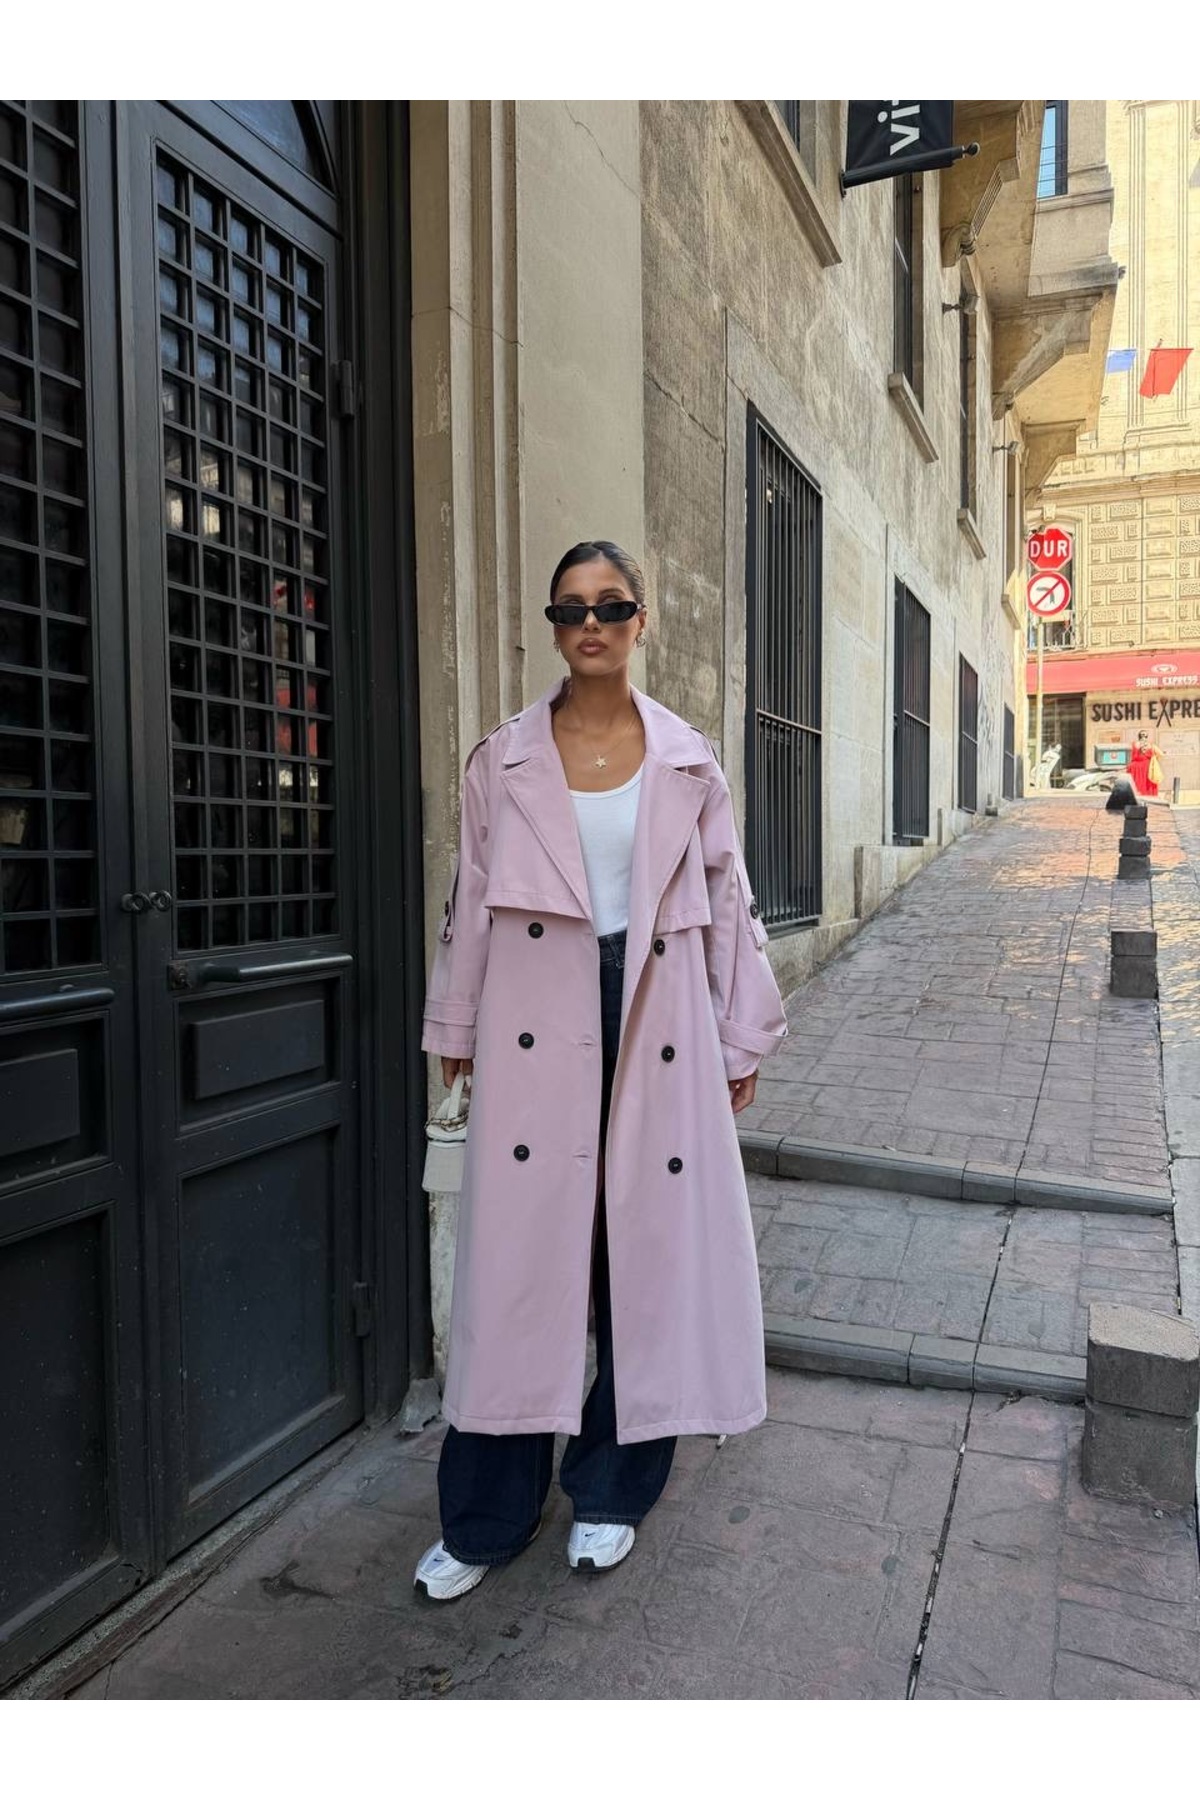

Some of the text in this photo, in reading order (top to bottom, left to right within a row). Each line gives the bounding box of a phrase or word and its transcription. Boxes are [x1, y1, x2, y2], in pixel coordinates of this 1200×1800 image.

[877, 100, 920, 156] vi
[1030, 540, 1068, 558] DUR
[1135, 675, 1198, 687] SUSHI EXPRESS
[1091, 701, 1141, 722] SUSHI
